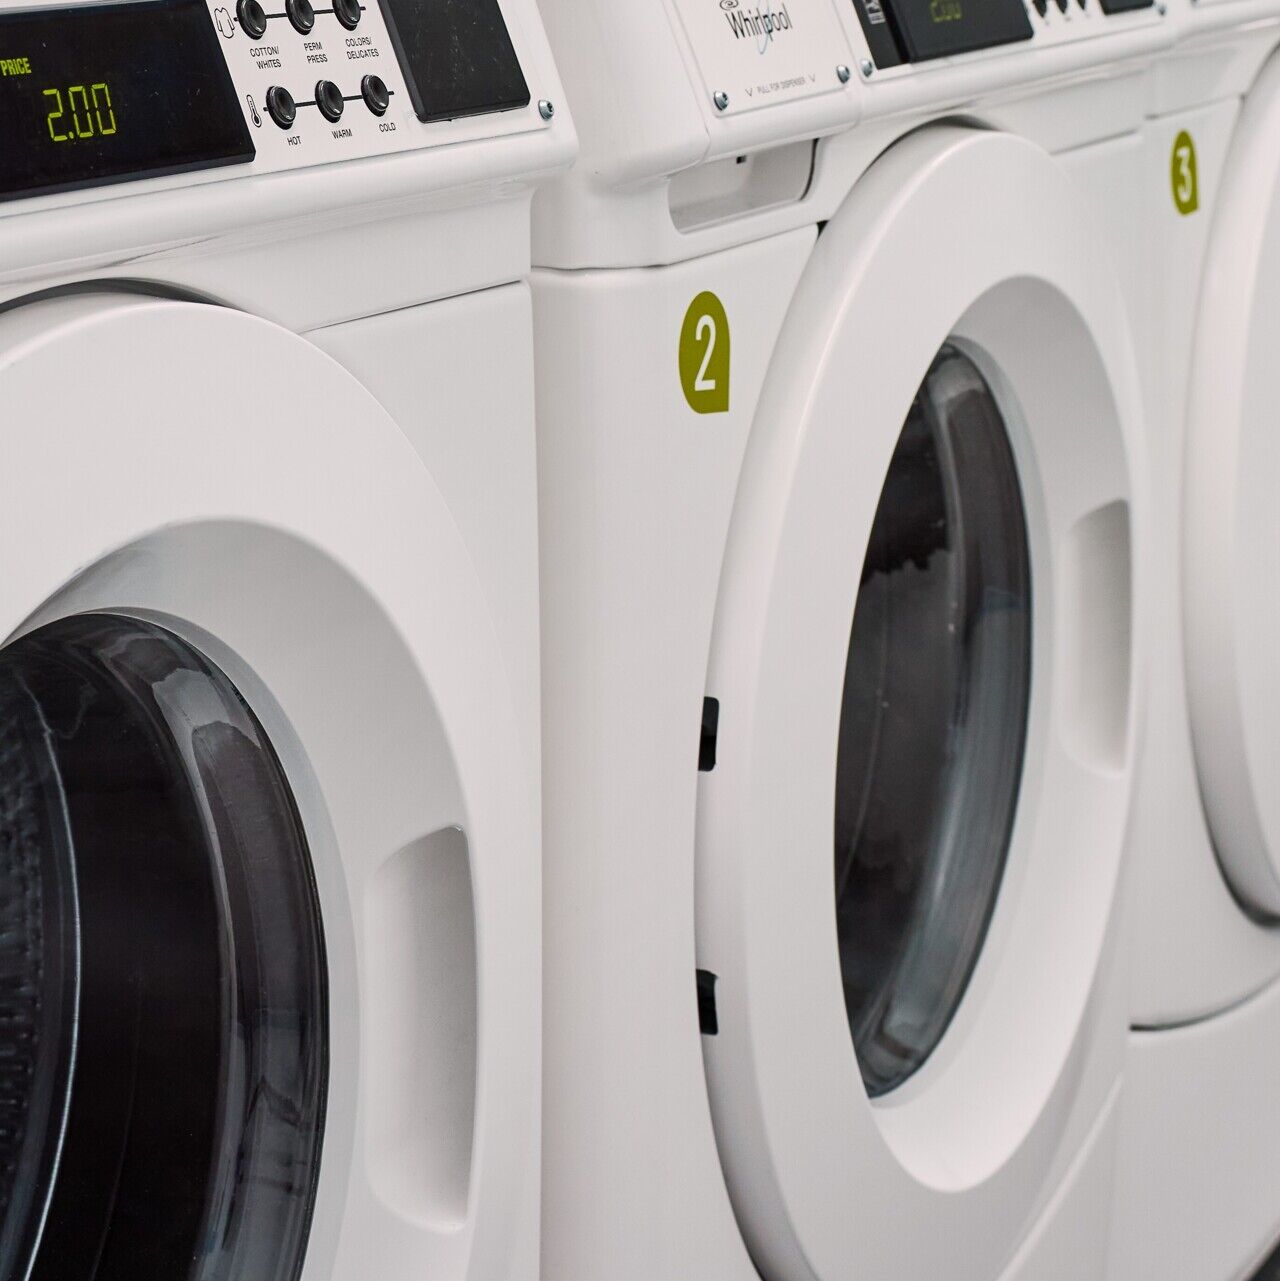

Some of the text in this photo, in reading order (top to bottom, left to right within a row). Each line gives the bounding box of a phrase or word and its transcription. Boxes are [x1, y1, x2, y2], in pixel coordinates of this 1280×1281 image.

[725, 3, 793, 42] Whirlpool
[304, 42, 323, 52] PERM
[345, 37, 373, 48] COLORS/
[249, 46, 279, 58] COTTON/
[346, 48, 380, 60] DELICATES
[256, 58, 282, 70] WHITES
[306, 54, 328, 64] PRESS
[0, 57, 32, 77] PRICE
[42, 83, 117, 142] 2.00
[378, 122, 396, 133] COLD
[332, 128, 353, 140] WARM
[287, 135, 302, 147] HOT
[1176, 147, 1192, 203] 3
[694, 314, 716, 392] 2
